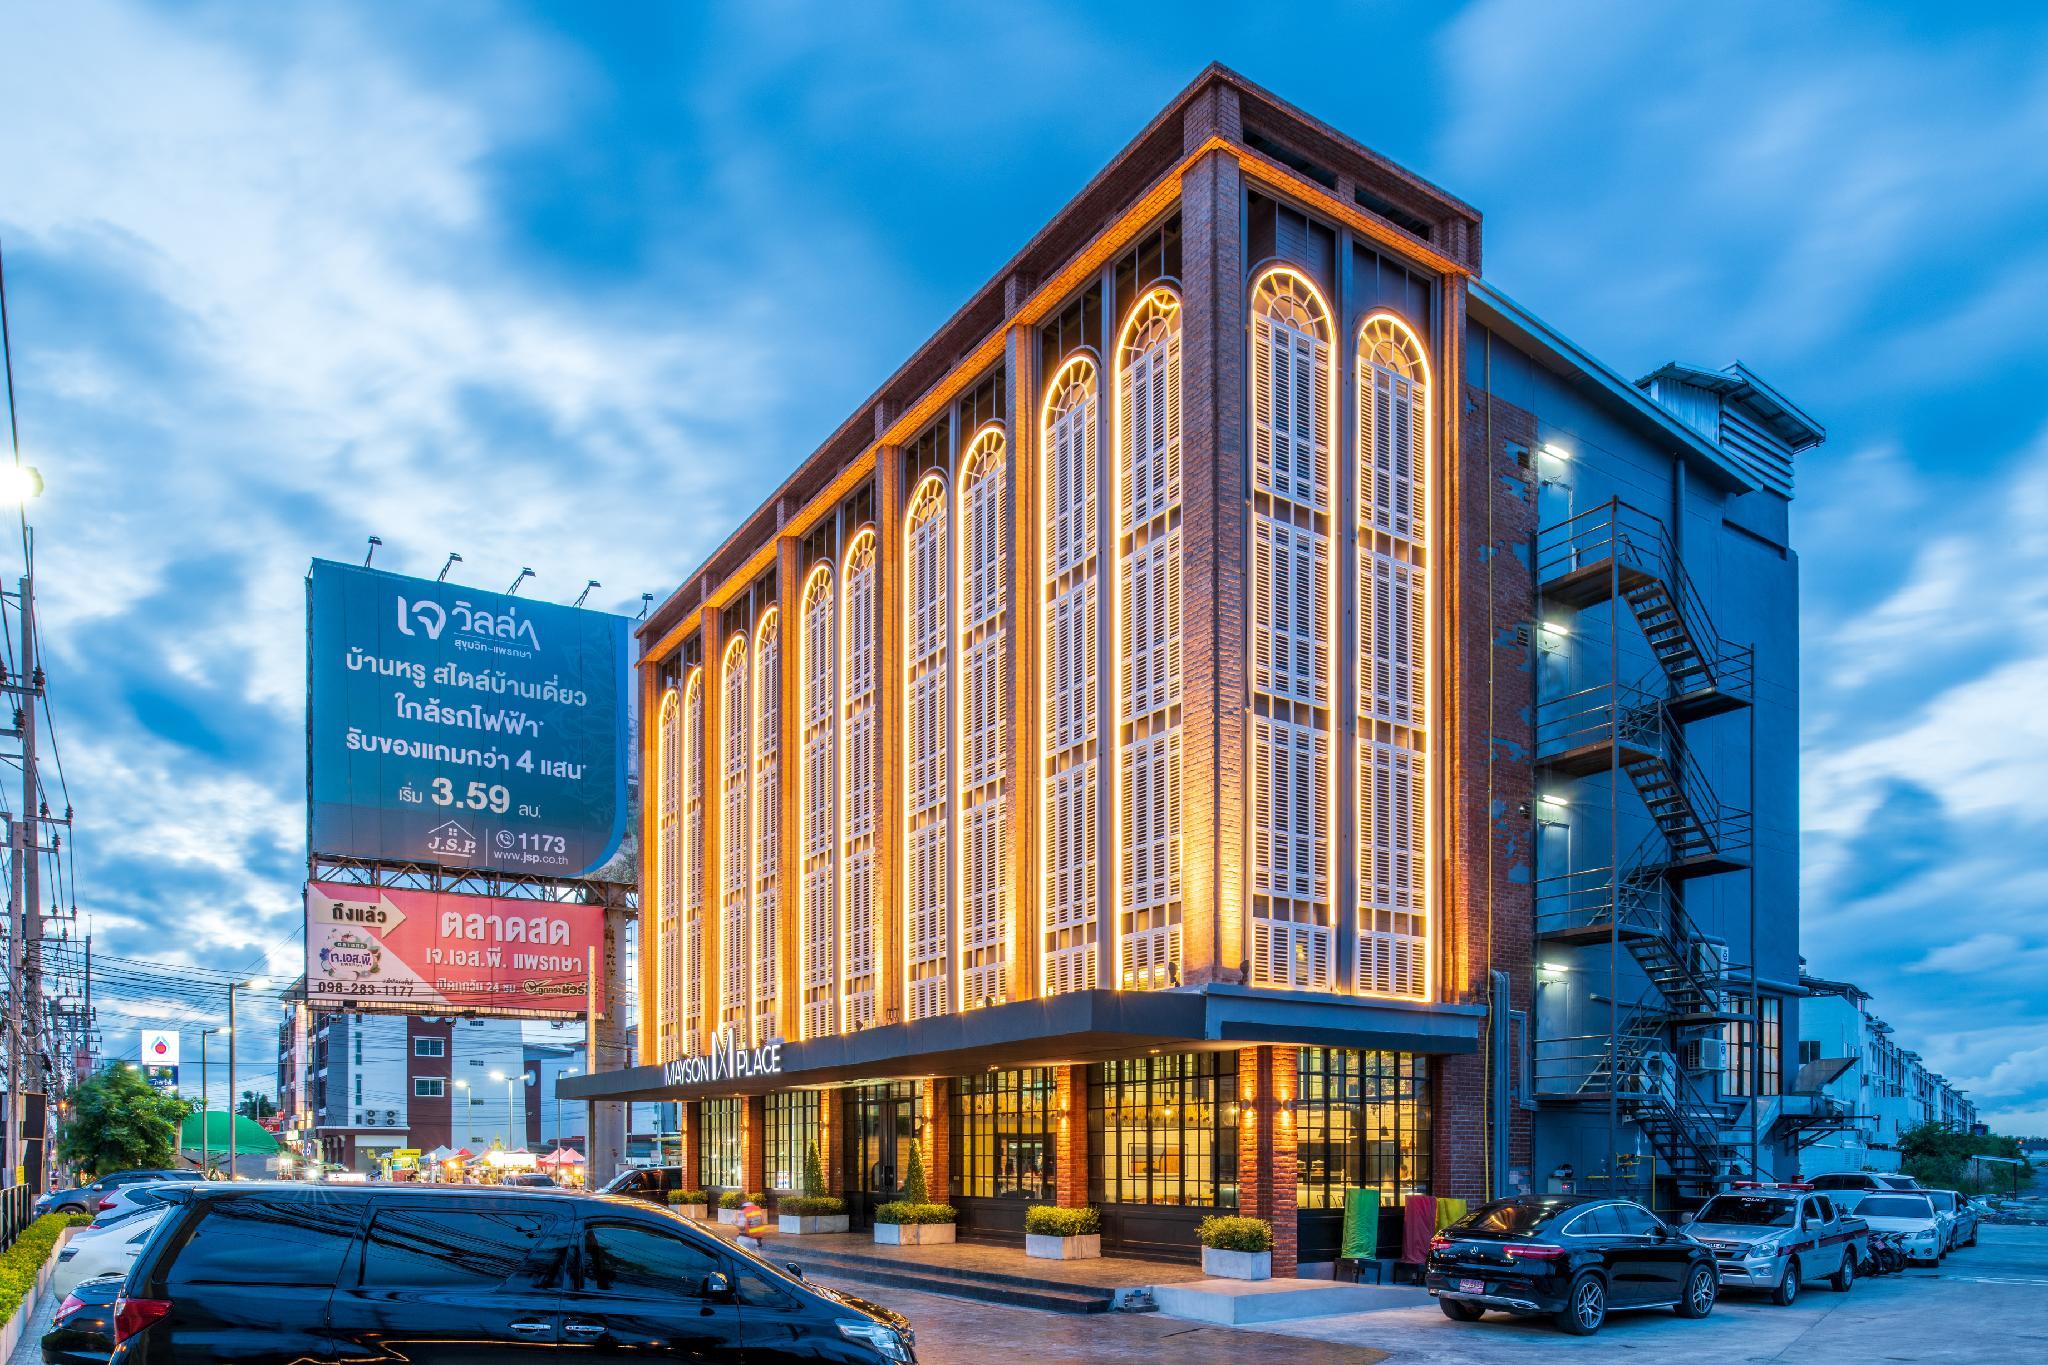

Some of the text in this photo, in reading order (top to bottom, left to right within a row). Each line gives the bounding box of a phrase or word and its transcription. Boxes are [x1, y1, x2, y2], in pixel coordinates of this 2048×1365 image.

[454, 639, 532, 660] สุขุมวิท-แพรกษา
[346, 646, 588, 707] บ้านหรู สไตล์บ้านเดี่ยว
[346, 727, 510, 771] รับของแถมกว่า
[516, 749, 535, 774] 4
[399, 781, 423, 804] เริ่ม
[431, 777, 511, 814] 3.59
[427, 832, 566, 854] J.S.P. 1173
[493, 850, 569, 866] www.jsp.co.th
[332, 902, 387, 924] ถึงแล้ว
[441, 910, 571, 946] ตลาดสด
[426, 946, 583, 973] เจ.เอส.พี. แพรกษา
[318, 981, 414, 997] 098-283-1177
[487, 983, 500, 993] 24
[665, 1055, 709, 1086] MAYSON
[736, 1044, 782, 1077] PLACE
